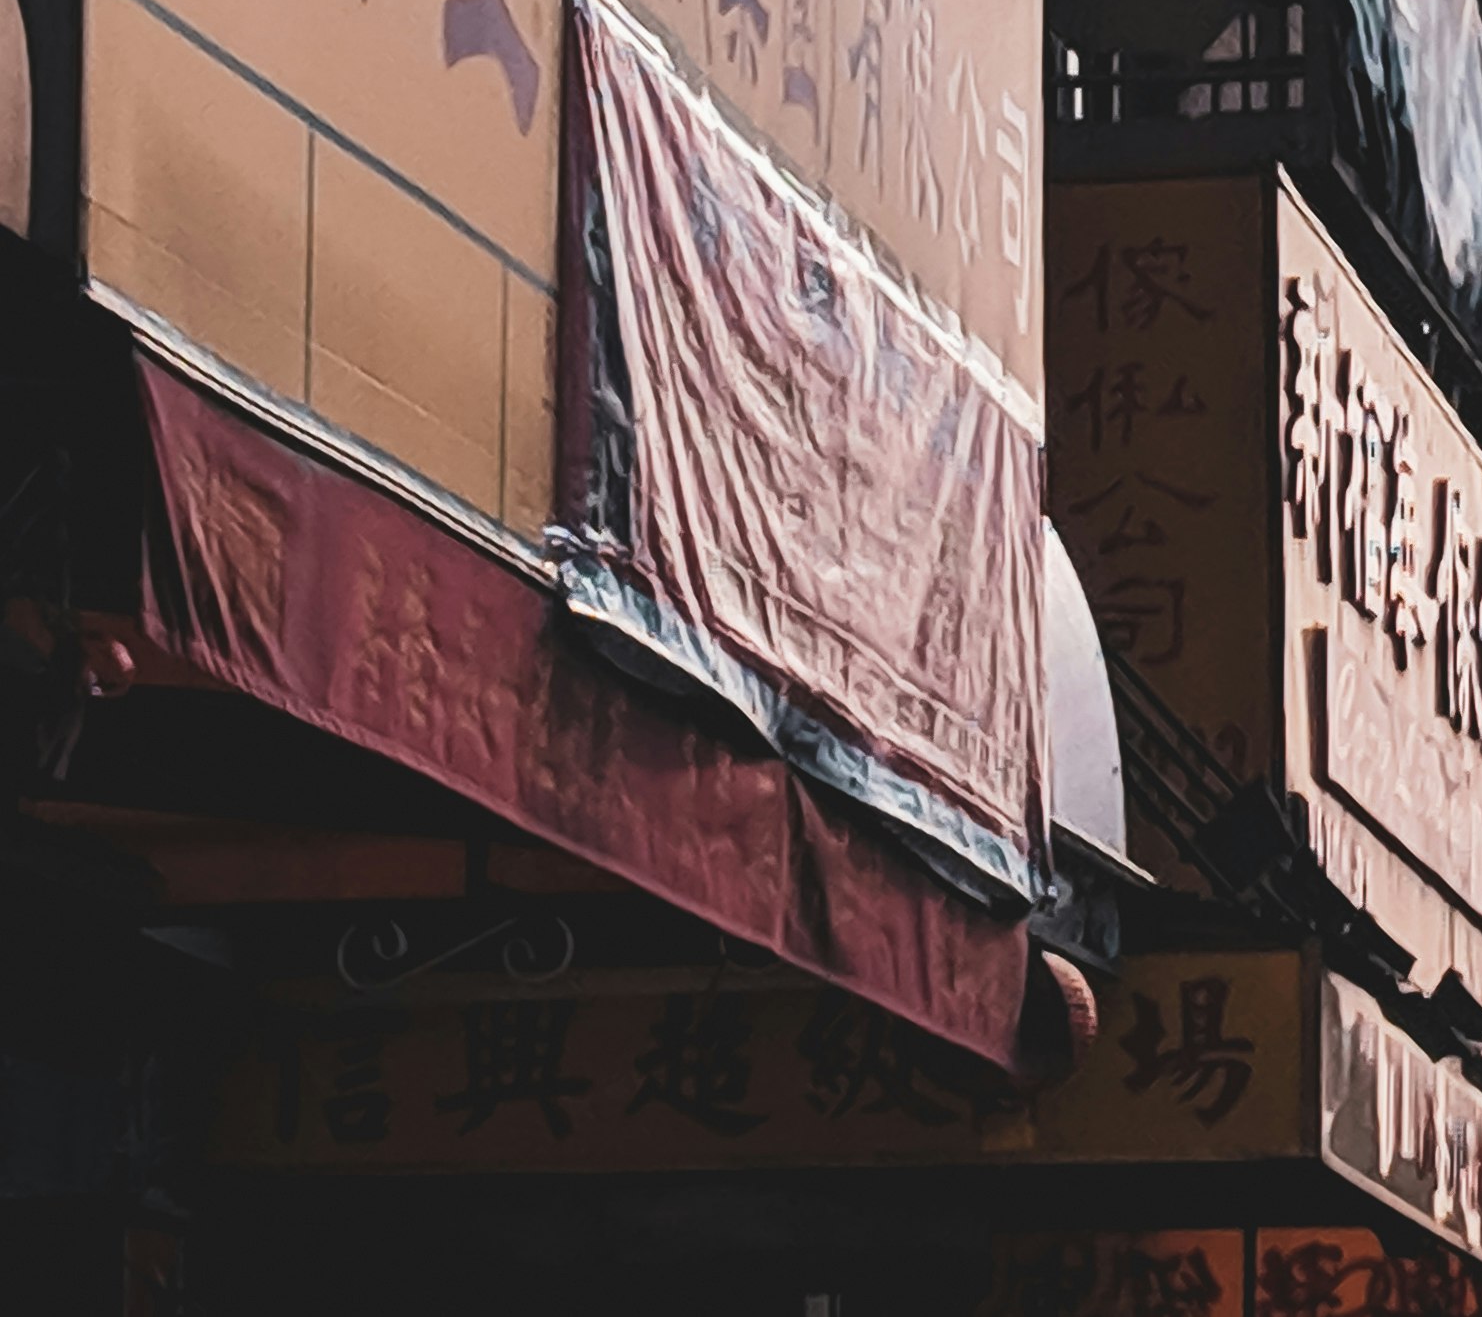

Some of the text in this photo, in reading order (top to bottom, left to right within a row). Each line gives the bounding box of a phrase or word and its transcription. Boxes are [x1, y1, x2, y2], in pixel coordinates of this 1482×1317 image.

[1062, 236, 1220, 666] 傢俬公司
[257, 976, 1256, 1146] 信興超級場
